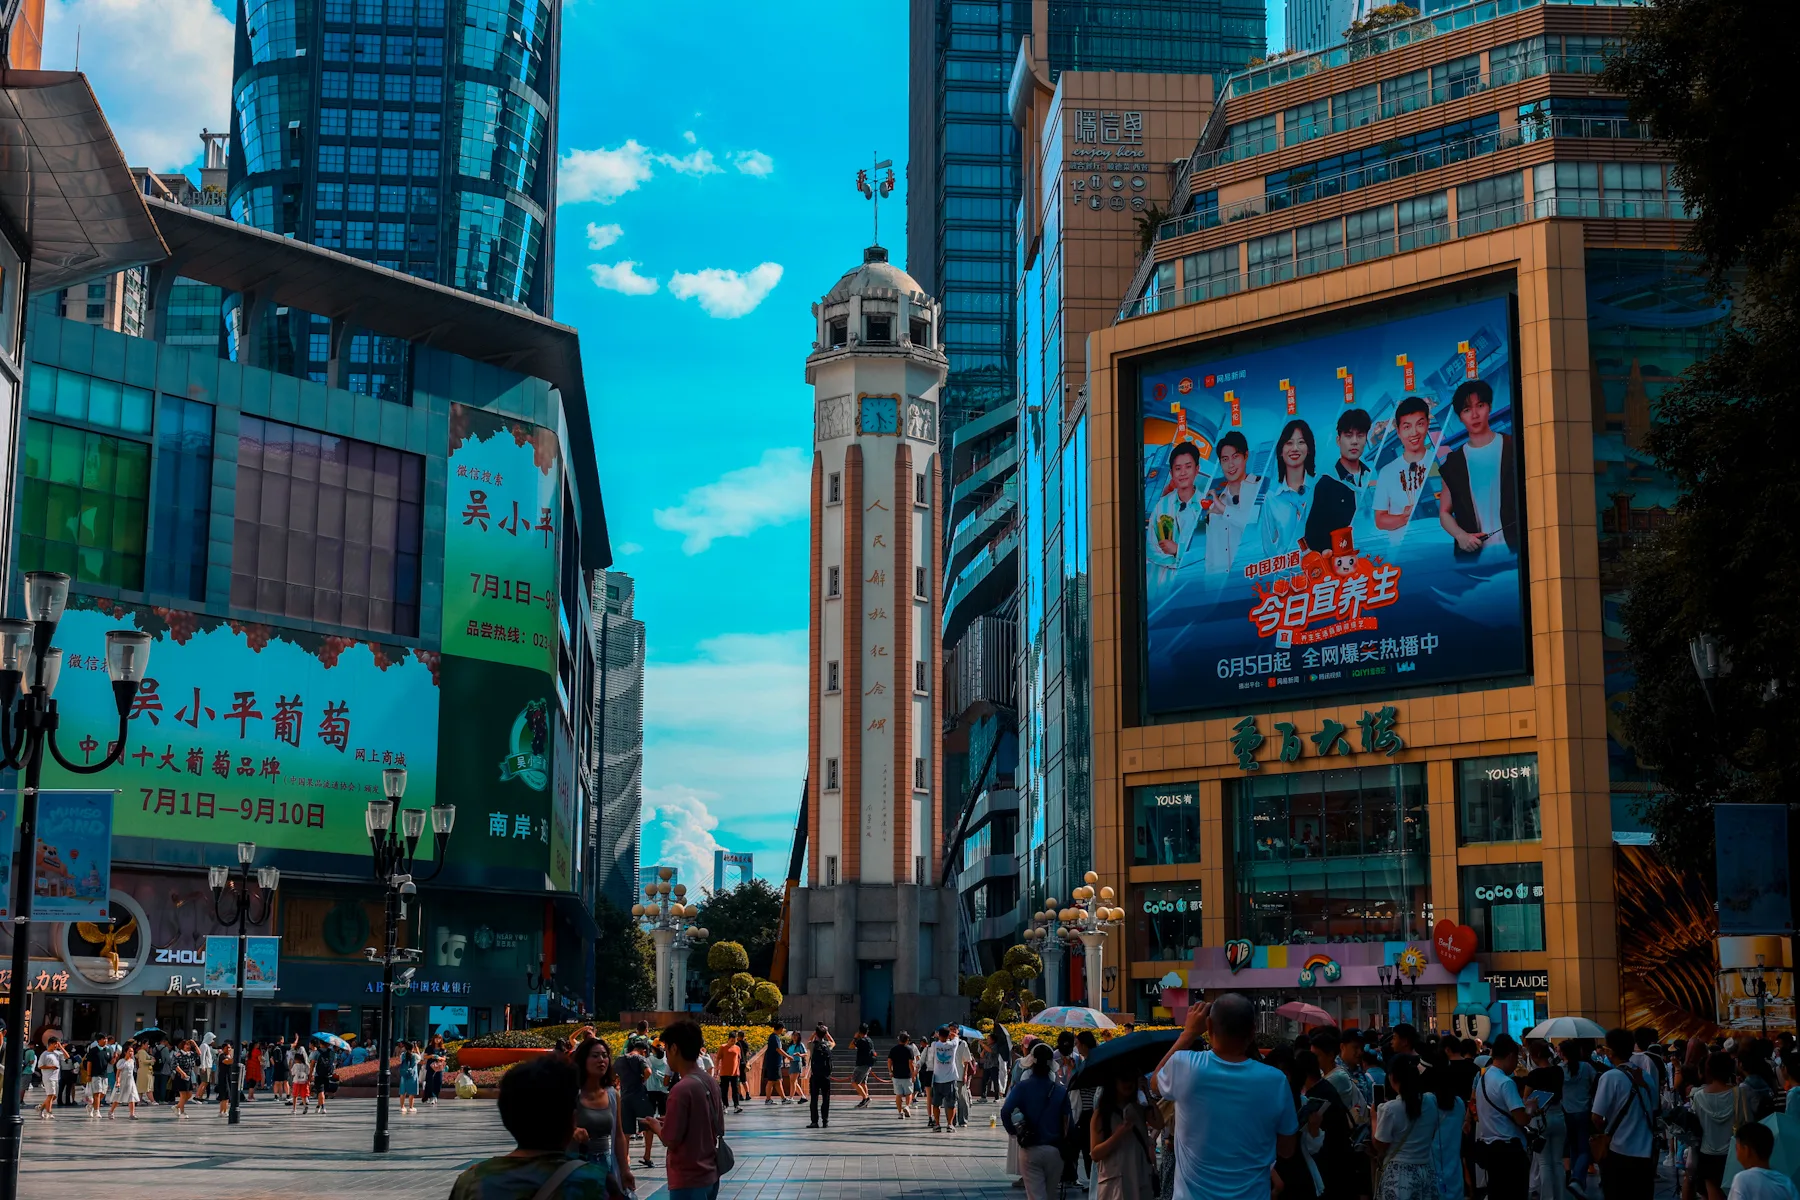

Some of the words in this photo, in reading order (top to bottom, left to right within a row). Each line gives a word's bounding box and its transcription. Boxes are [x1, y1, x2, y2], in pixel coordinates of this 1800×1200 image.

[1071, 146, 1113, 161] enjoy
[1115, 145, 1145, 157] here
[1071, 180, 1085, 191] 12
[1074, 194, 1083, 206] F
[1216, 370, 1247, 384] 网易新闻
[456, 464, 504, 486] 微信搜索
[461, 489, 555, 549] 吴小平
[1245, 550, 1300, 579] 中国劲酒
[1252, 566, 1399, 632] 今日宜养生
[1217, 651, 1292, 679] 6月5日起
[1302, 633, 1439, 669] 全网爆笑热播中
[128, 677, 351, 753] 吴小平葡萄
[354, 748, 408, 767] 网上商城
[1485, 767, 1518, 781] YOUS
[140, 788, 325, 828] 7月1日—9月10日
[1155, 795, 1182, 806] YOUS
[1475, 885, 1513, 901] CoCo
[1143, 899, 1174, 915] CoCo
[409, 980, 472, 994] 中国农业银行
